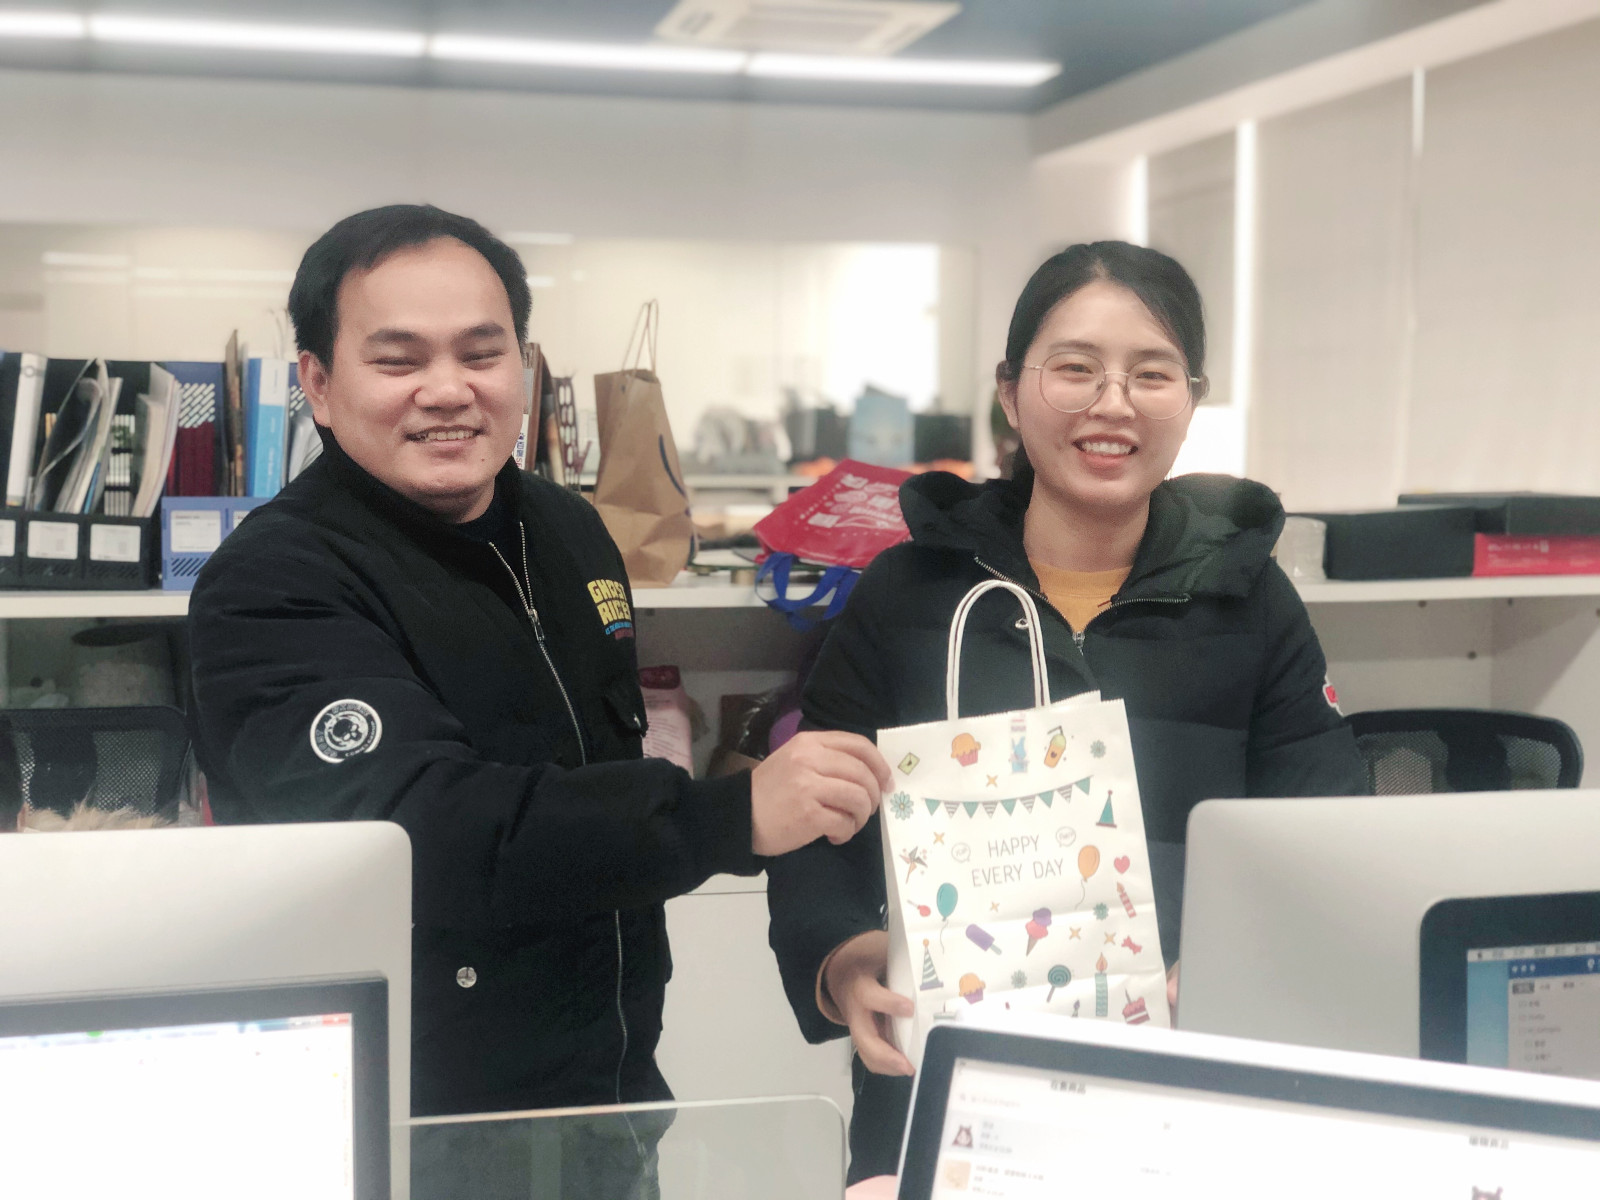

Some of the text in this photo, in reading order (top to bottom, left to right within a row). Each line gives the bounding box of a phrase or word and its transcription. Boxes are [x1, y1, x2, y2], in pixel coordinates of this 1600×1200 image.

[988, 834, 1039, 858] HAPPY
[971, 858, 1063, 888] EVERY DAY
